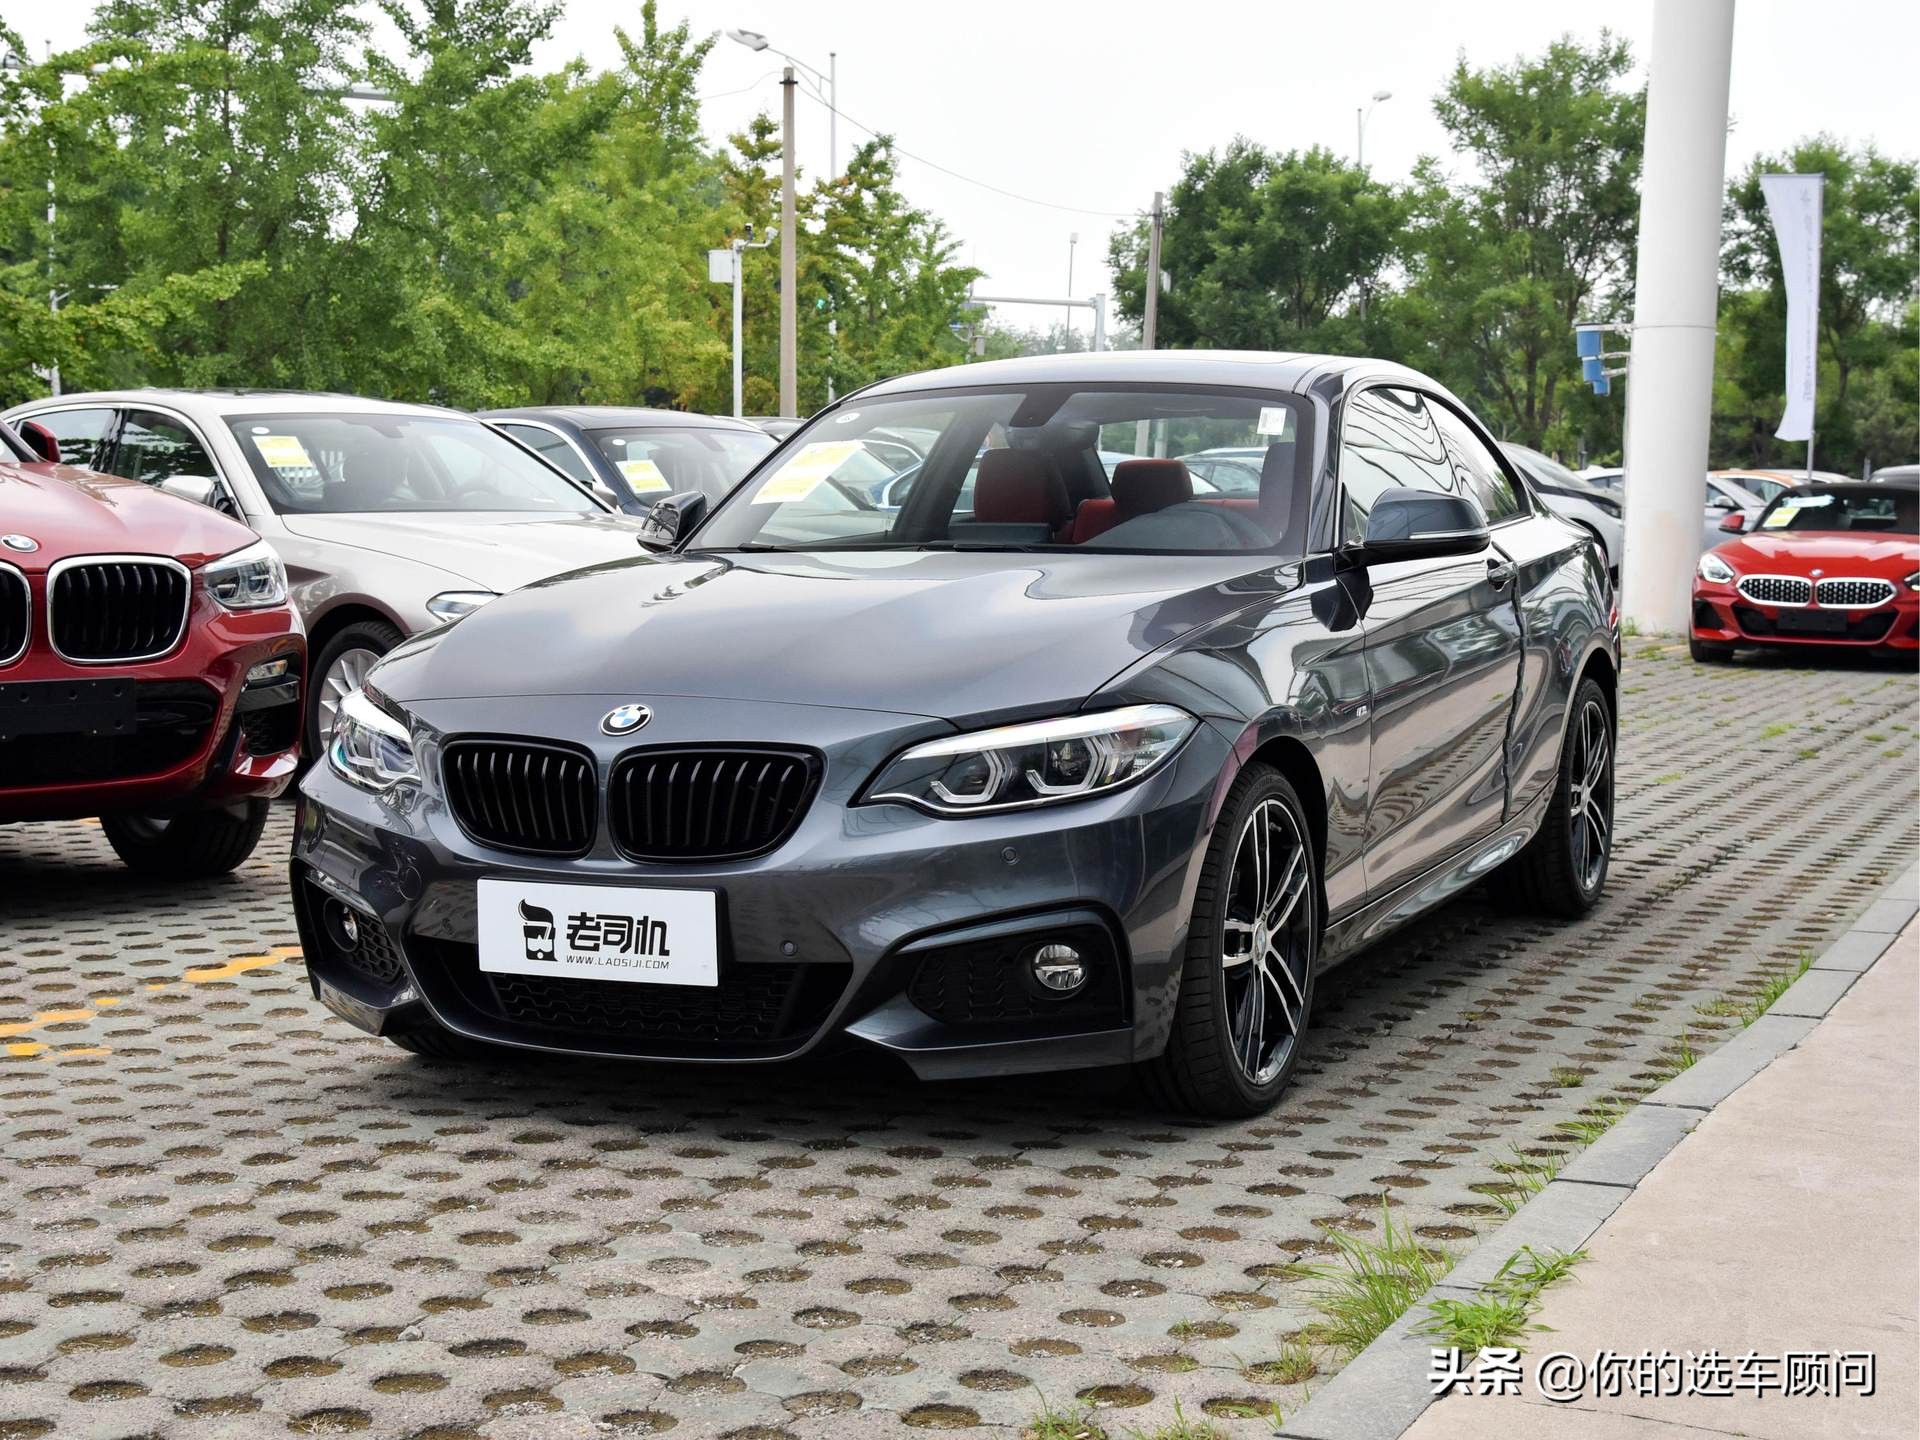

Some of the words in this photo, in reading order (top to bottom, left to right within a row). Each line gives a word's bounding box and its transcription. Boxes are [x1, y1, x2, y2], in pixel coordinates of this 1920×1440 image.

[567, 912, 670, 956] 老司机
[566, 955, 670, 970] WWW.LAOSIJI.COM
